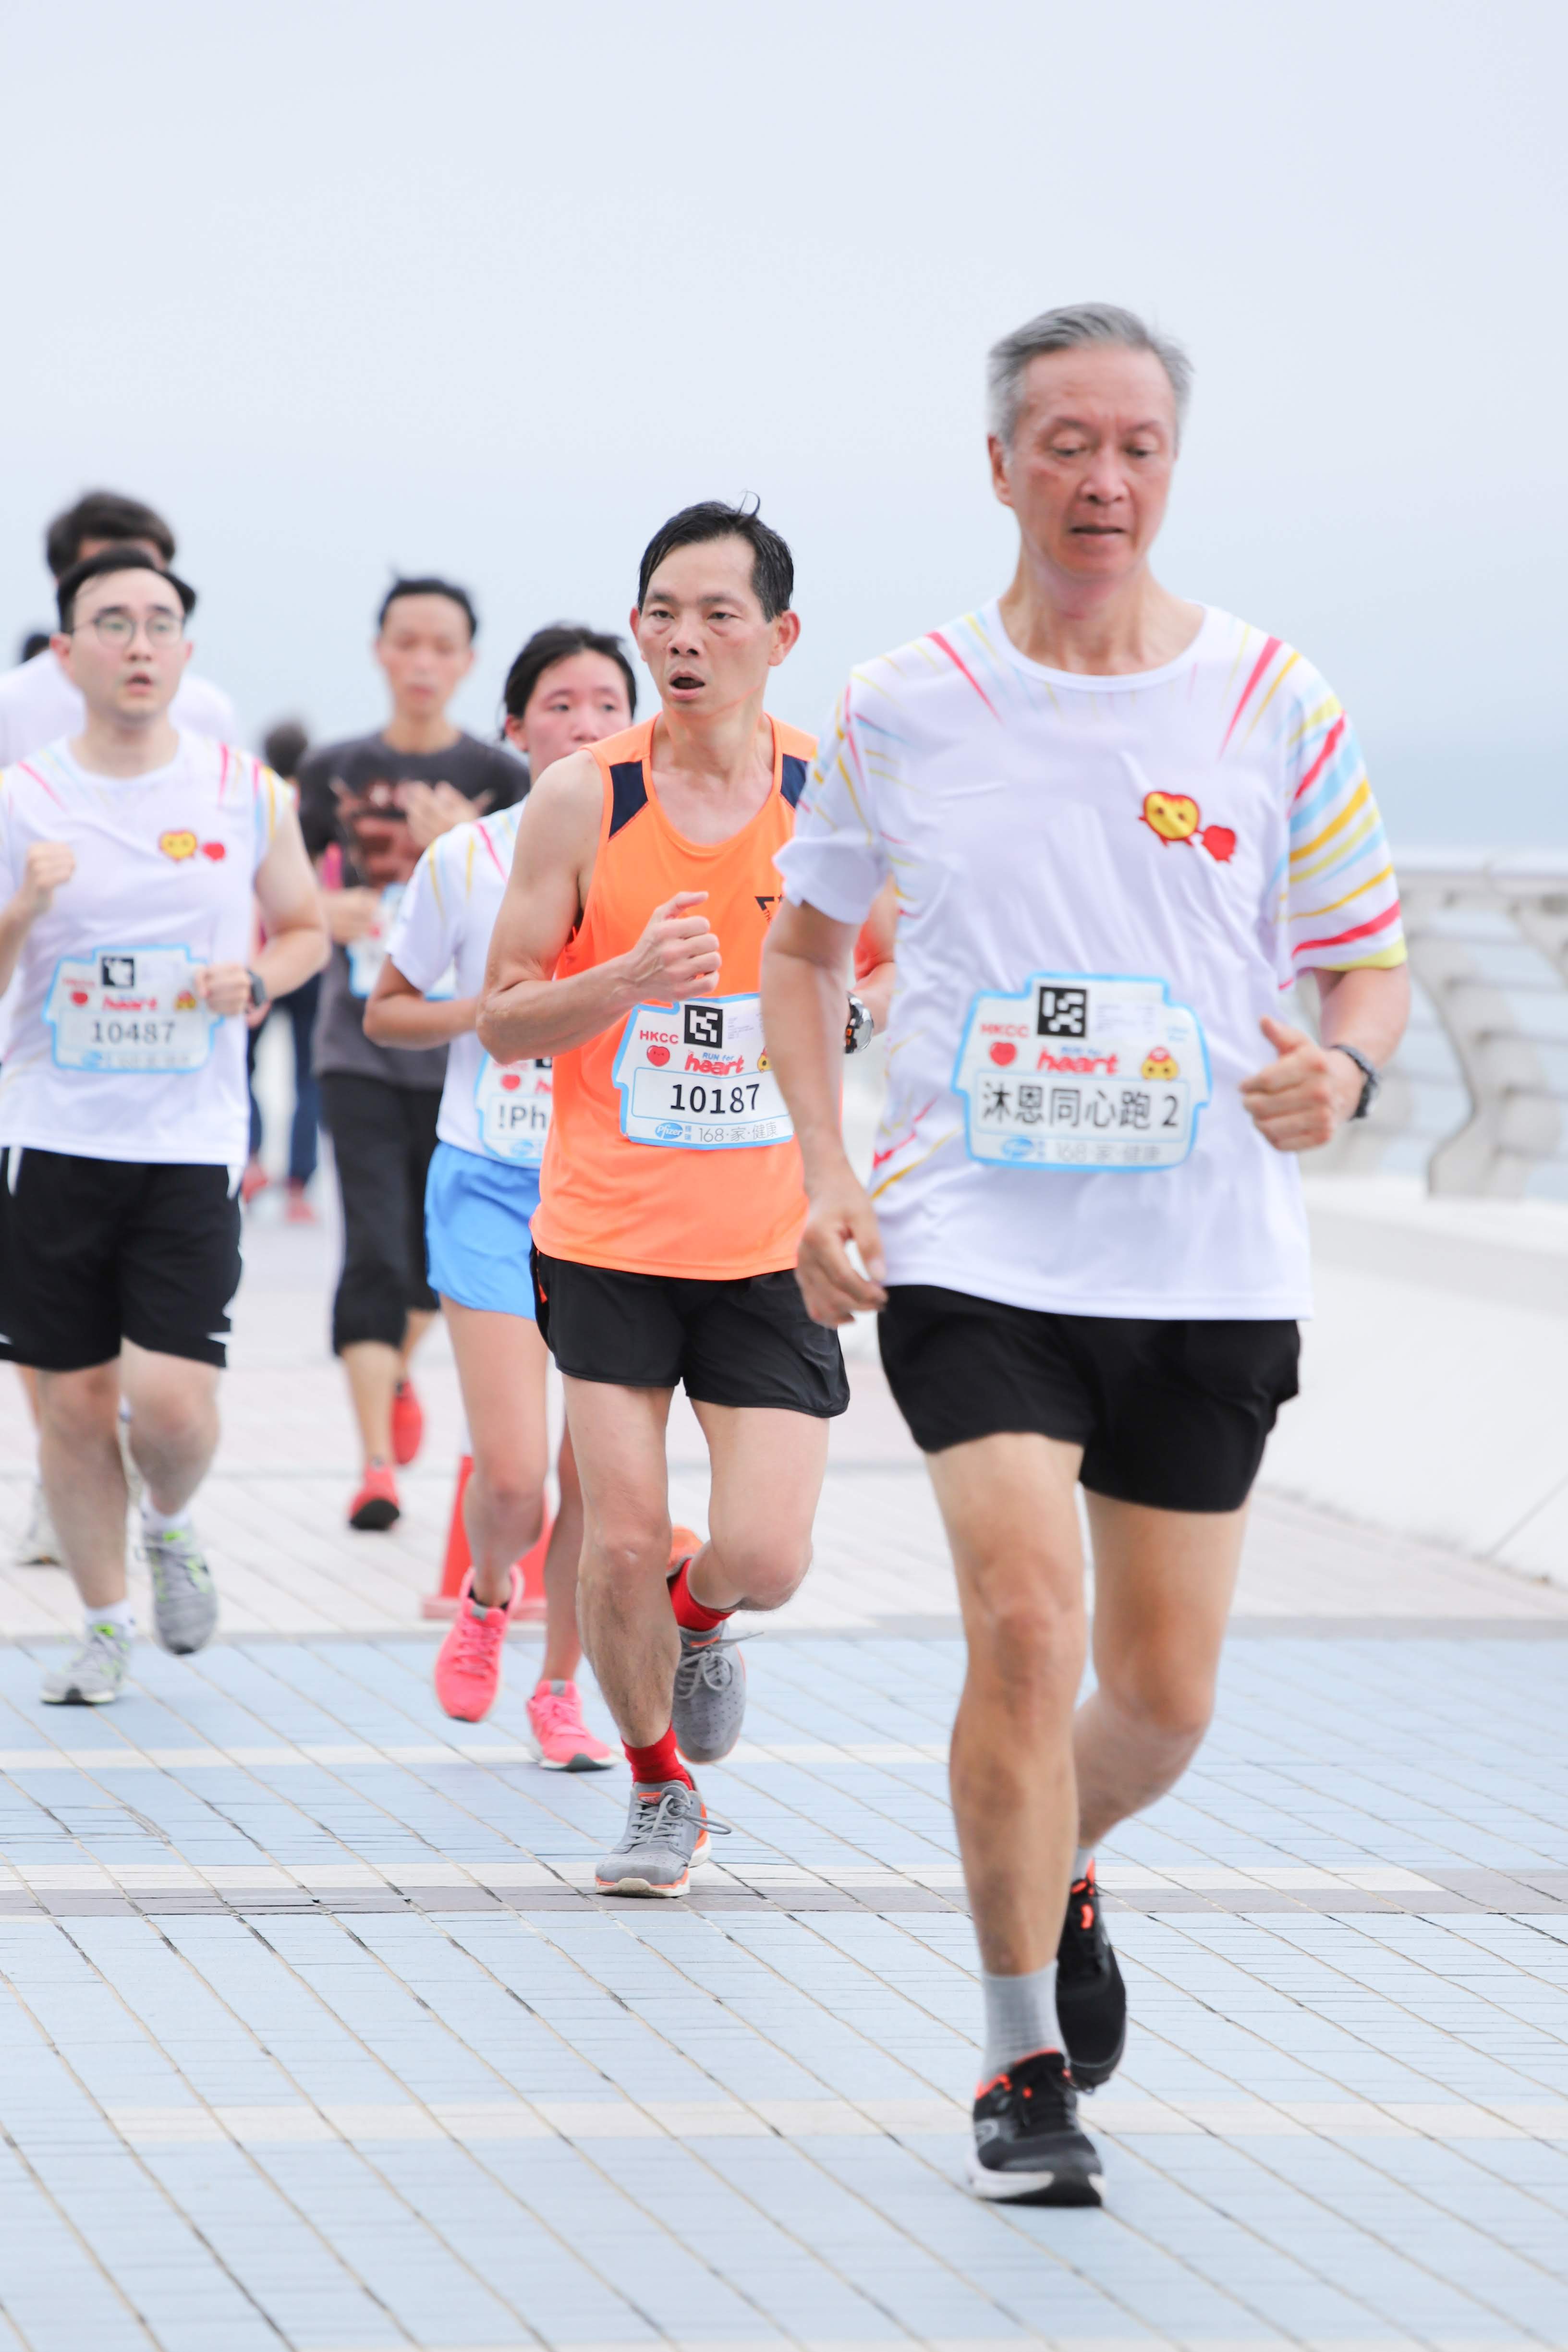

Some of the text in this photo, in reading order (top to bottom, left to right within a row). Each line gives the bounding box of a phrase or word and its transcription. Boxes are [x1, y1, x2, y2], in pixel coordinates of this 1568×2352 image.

[92, 1020, 175, 1044] 10487
[640, 1030, 679, 1044] HKCC
[980, 1023, 1030, 1038] HKCC
[685, 1053, 744, 1075] heart
[702, 1052, 719, 1060] RUN
[1037, 1049, 1117, 1074] heart
[670, 1084, 760, 1114] 10187
[983, 1081, 1179, 1130] 沐恩同心跑 2
[656, 1125, 682, 1140] Pfizer
